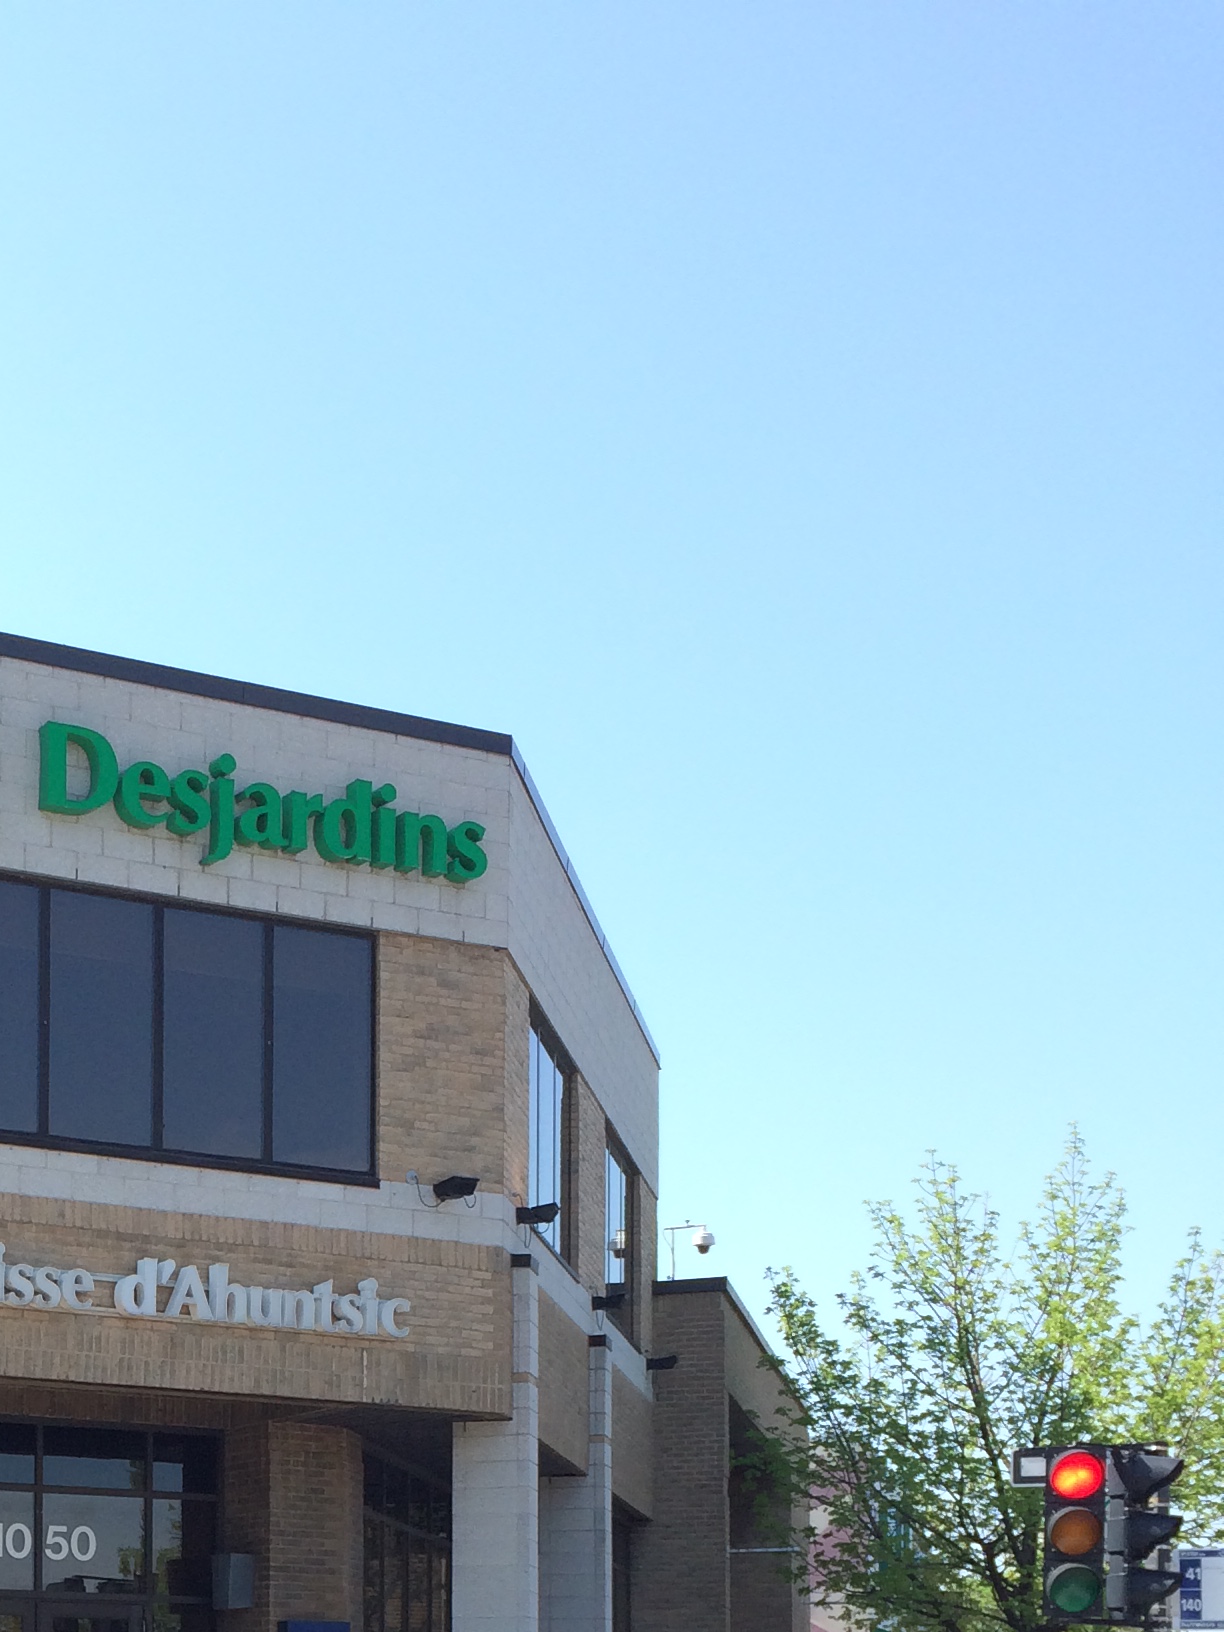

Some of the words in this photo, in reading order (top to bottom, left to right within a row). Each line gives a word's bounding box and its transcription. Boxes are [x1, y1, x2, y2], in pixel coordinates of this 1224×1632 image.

[38, 720, 488, 883] Desjardins
[114, 1256, 411, 1338] d'Ahuntsic
[1185, 1566, 1202, 1581] 41
[1180, 1598, 1203, 1612] 140
